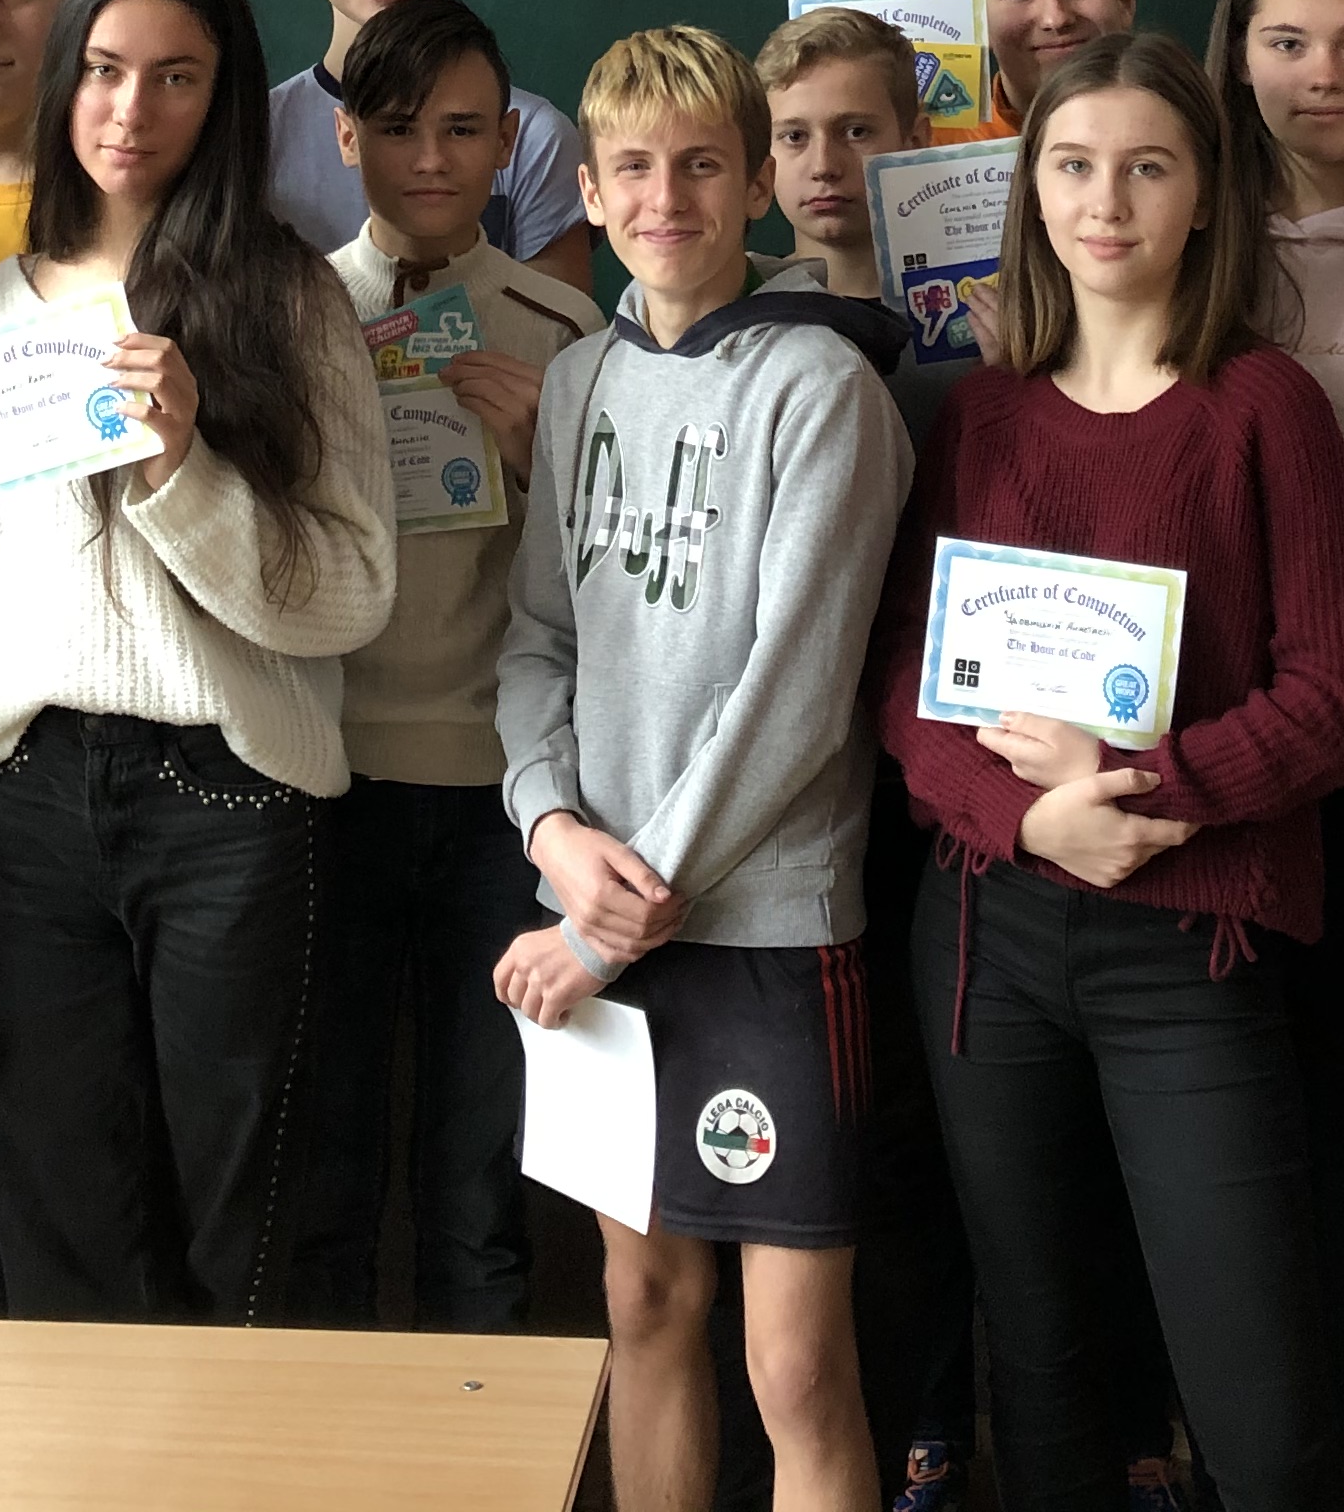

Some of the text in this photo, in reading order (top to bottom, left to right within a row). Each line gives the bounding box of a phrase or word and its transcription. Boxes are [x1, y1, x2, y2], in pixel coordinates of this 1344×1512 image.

[892, 7, 962, 42] Completion
[897, 174, 962, 218] Certificate
[965, 167, 981, 186] of
[3, 344, 18, 364] of
[390, 405, 468, 437] Completion
[960, 583, 1147, 642] Certificate of Completion
[1006, 637, 1027, 652] The
[1071, 648, 1097, 662] Code
[705, 1097, 770, 1132] LEGA CALCIO
